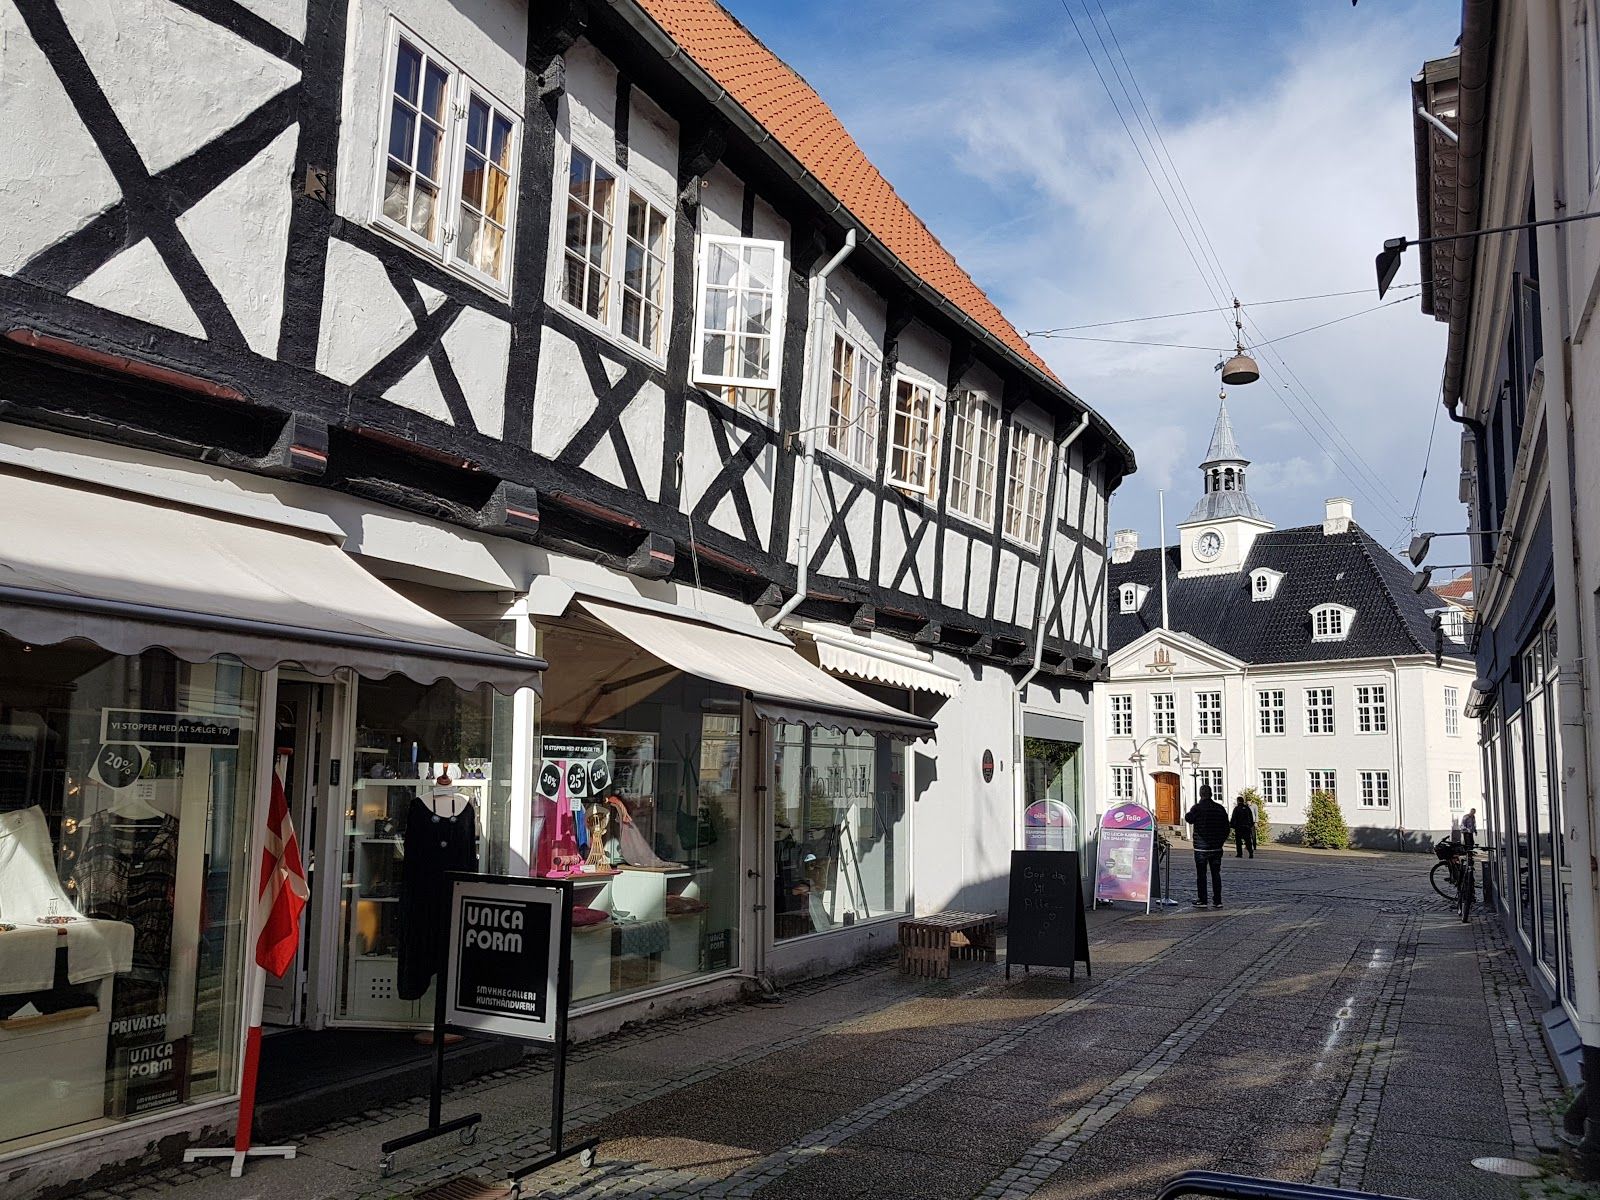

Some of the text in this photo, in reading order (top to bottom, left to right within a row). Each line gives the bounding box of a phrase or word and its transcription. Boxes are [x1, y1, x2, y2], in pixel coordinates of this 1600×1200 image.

[111, 722, 231, 736] VI STOPPER MED AT SÆLGE TØJ
[105, 751, 134, 775] 20%
[543, 772, 557, 788] 30%
[569, 768, 584, 788] 25%
[593, 767, 606, 782] 20%
[1125, 814, 1141, 822] Telia
[467, 906, 524, 930] UNICA
[465, 928, 523, 953] FORM
[476, 985, 537, 1001] SMYKKEGALLERI
[476, 995, 536, 1012] KUNSTHÅNDVÆRK
[130, 1043, 174, 1063] UNICA
[129, 1058, 173, 1079] FORM
